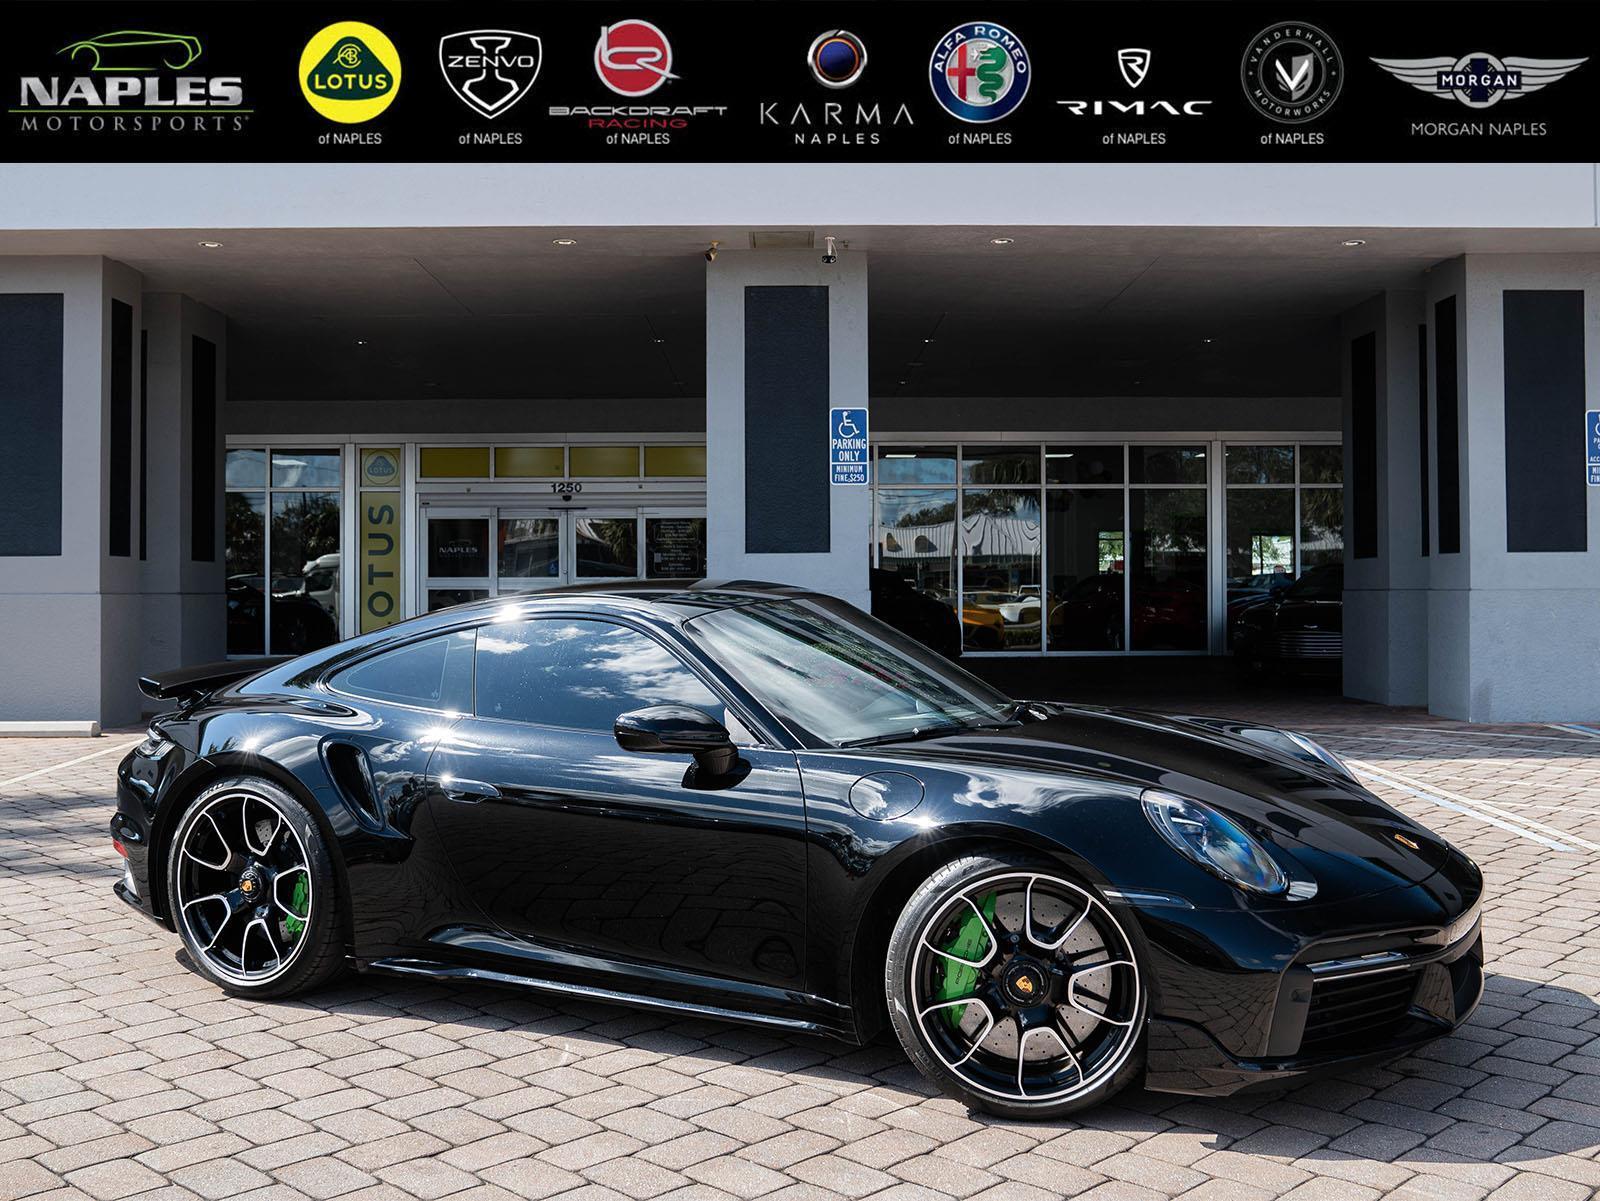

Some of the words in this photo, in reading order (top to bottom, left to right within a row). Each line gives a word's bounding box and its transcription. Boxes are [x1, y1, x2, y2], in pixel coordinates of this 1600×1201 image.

[832, 438, 867, 450] PARKING
[838, 450, 860, 462] ONLY
[836, 465, 863, 473] MINIMUM
[551, 482, 582, 493] 1250
[367, 504, 395, 624] OTUS
